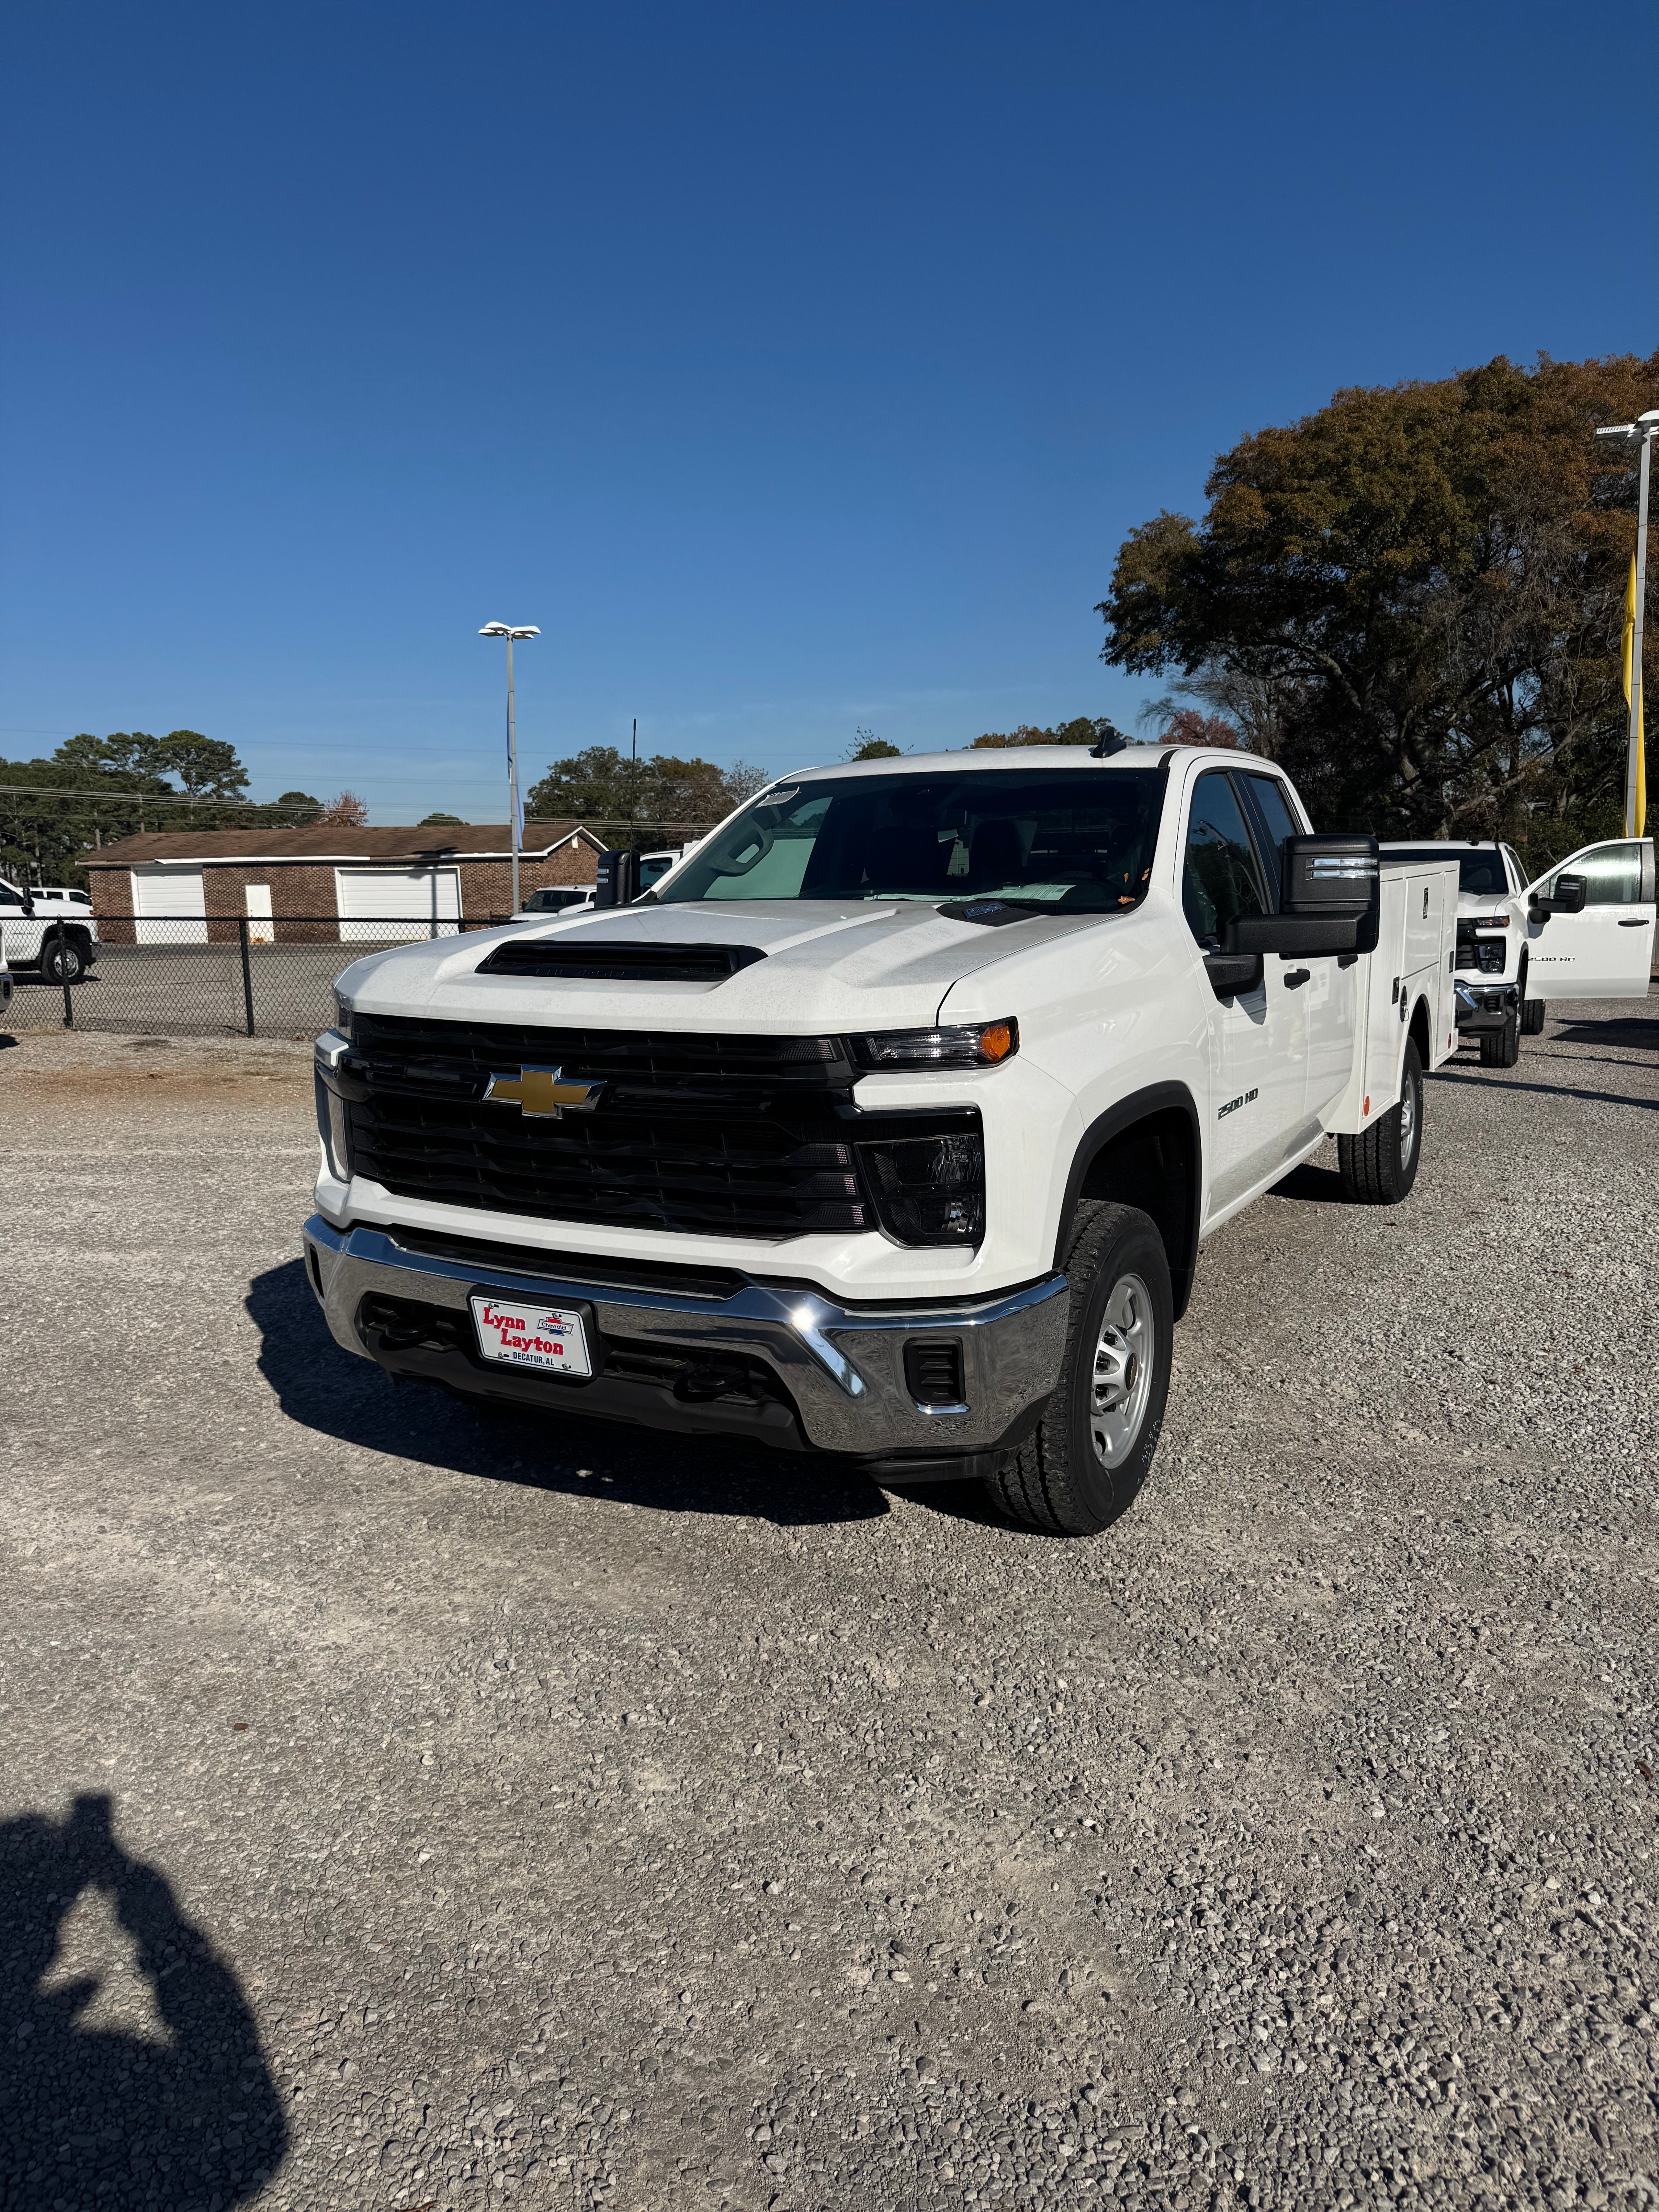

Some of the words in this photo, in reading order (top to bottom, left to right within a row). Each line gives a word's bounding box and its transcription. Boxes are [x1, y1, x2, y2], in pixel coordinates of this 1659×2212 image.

[1218, 1096, 1243, 1121] 2500
[1245, 1088, 1258, 1104] HD
[483, 1307, 526, 1331] Lynn
[541, 1322, 567, 1331] Chevrolet
[501, 1328, 563, 1355] Layton
